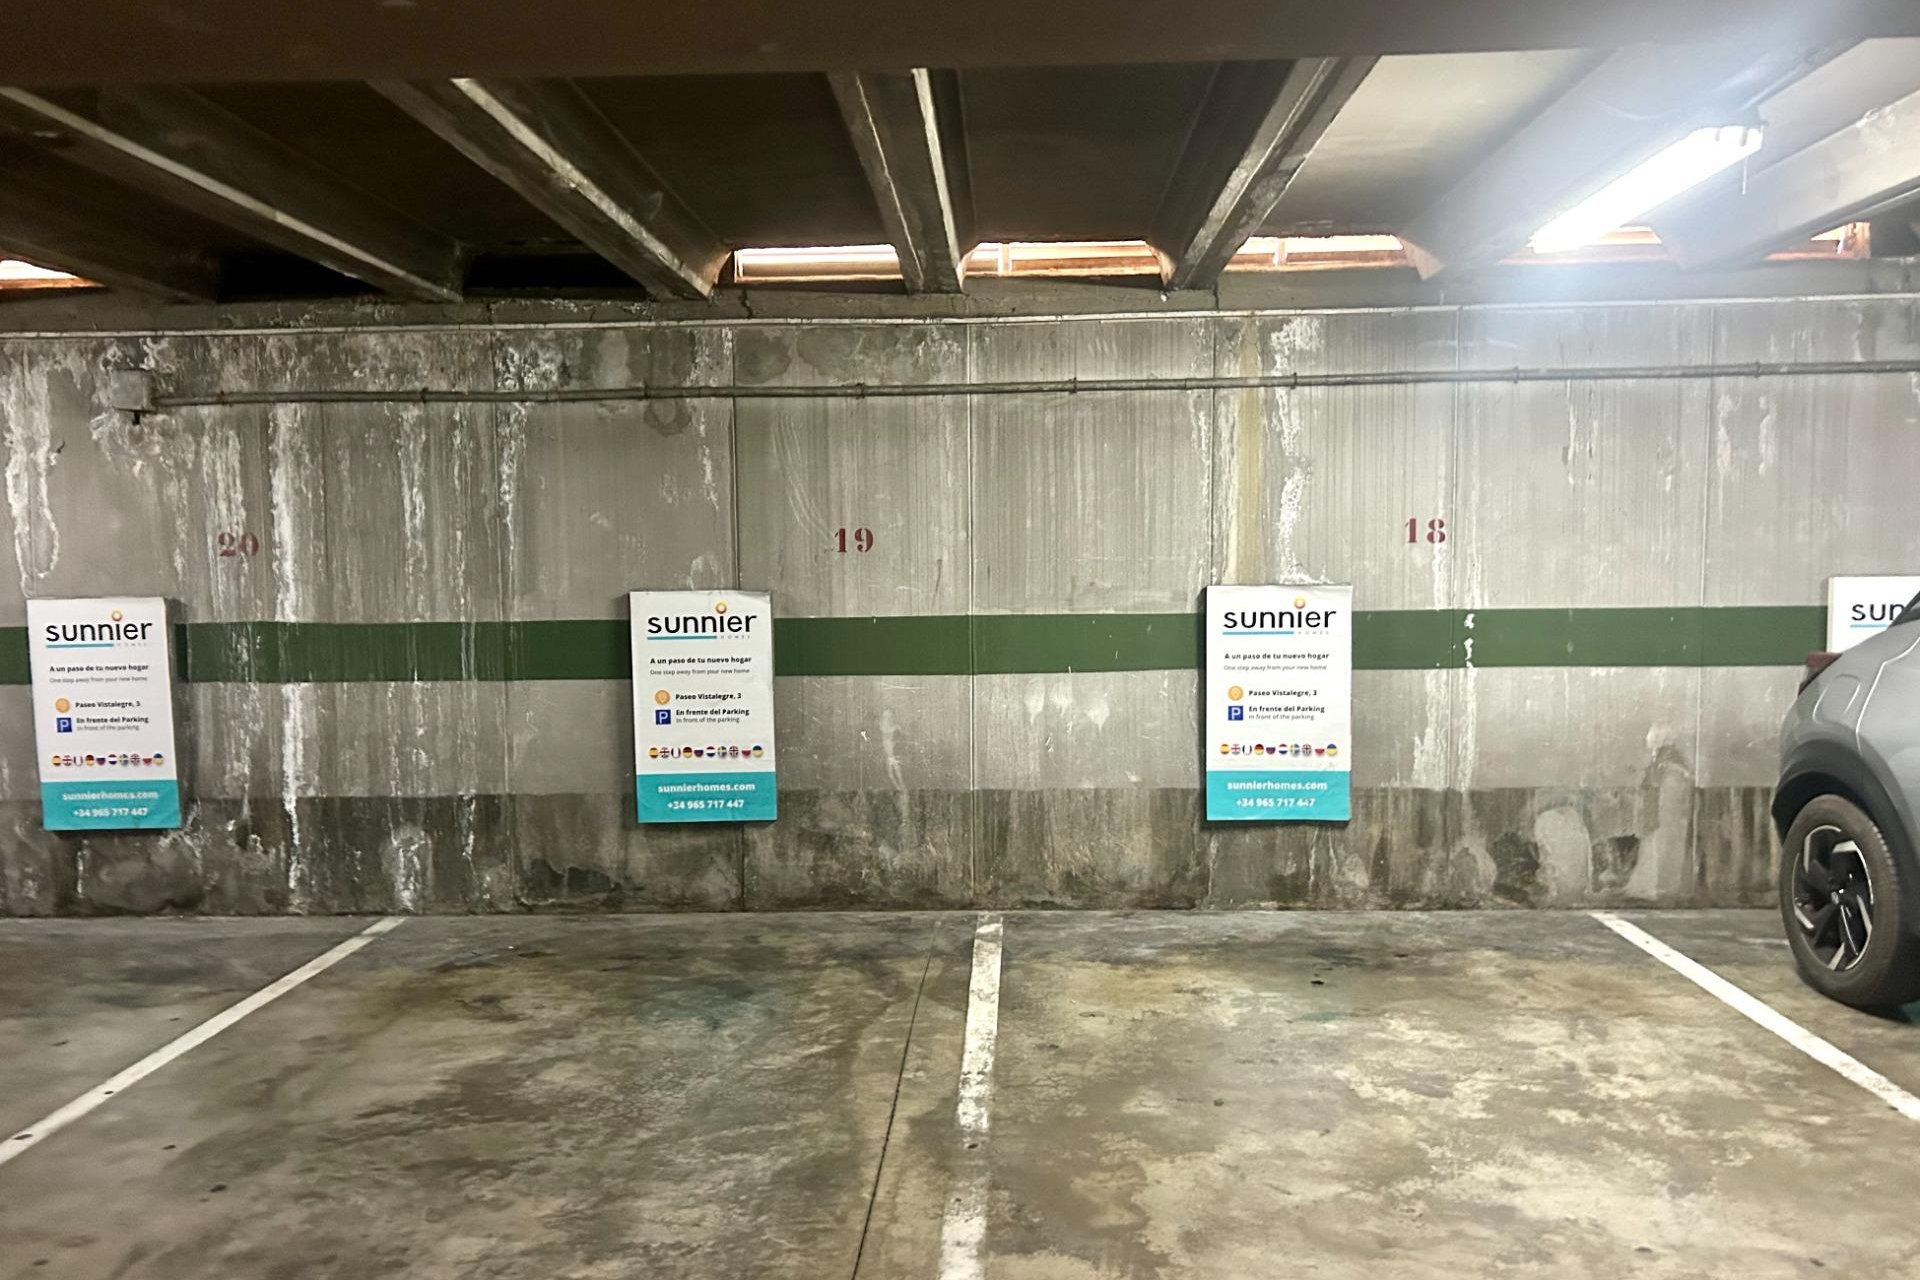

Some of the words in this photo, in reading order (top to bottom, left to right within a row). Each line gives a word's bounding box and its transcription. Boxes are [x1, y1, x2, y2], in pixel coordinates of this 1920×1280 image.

[1405, 518, 1445, 544] 18
[218, 532, 259, 557] 20
[835, 528, 873, 552] 19
[647, 603, 757, 634] sunnier
[1223, 599, 1336, 628] sunnier
[46, 611, 153, 642] sunnier
[659, 712, 668, 724] P
[722, 708, 750, 716] Parking
[1231, 707, 1241, 719] P
[658, 783, 755, 793] sunnierhomes.com
[1227, 781, 1328, 790] sunnierhomes.com
[63, 791, 158, 800] sunnierhomes.com
[667, 801, 686, 809] +34
[687, 801, 704, 809] 965
[708, 800, 724, 808] 717
[727, 800, 744, 808] 447
[1236, 799, 1254, 807] +34
[1256, 798, 1274, 807] 965
[1277, 798, 1293, 807] 717
[1296, 798, 1315, 807] 447
[73, 809, 90, 817] +34
[131, 808, 148, 816] 447
